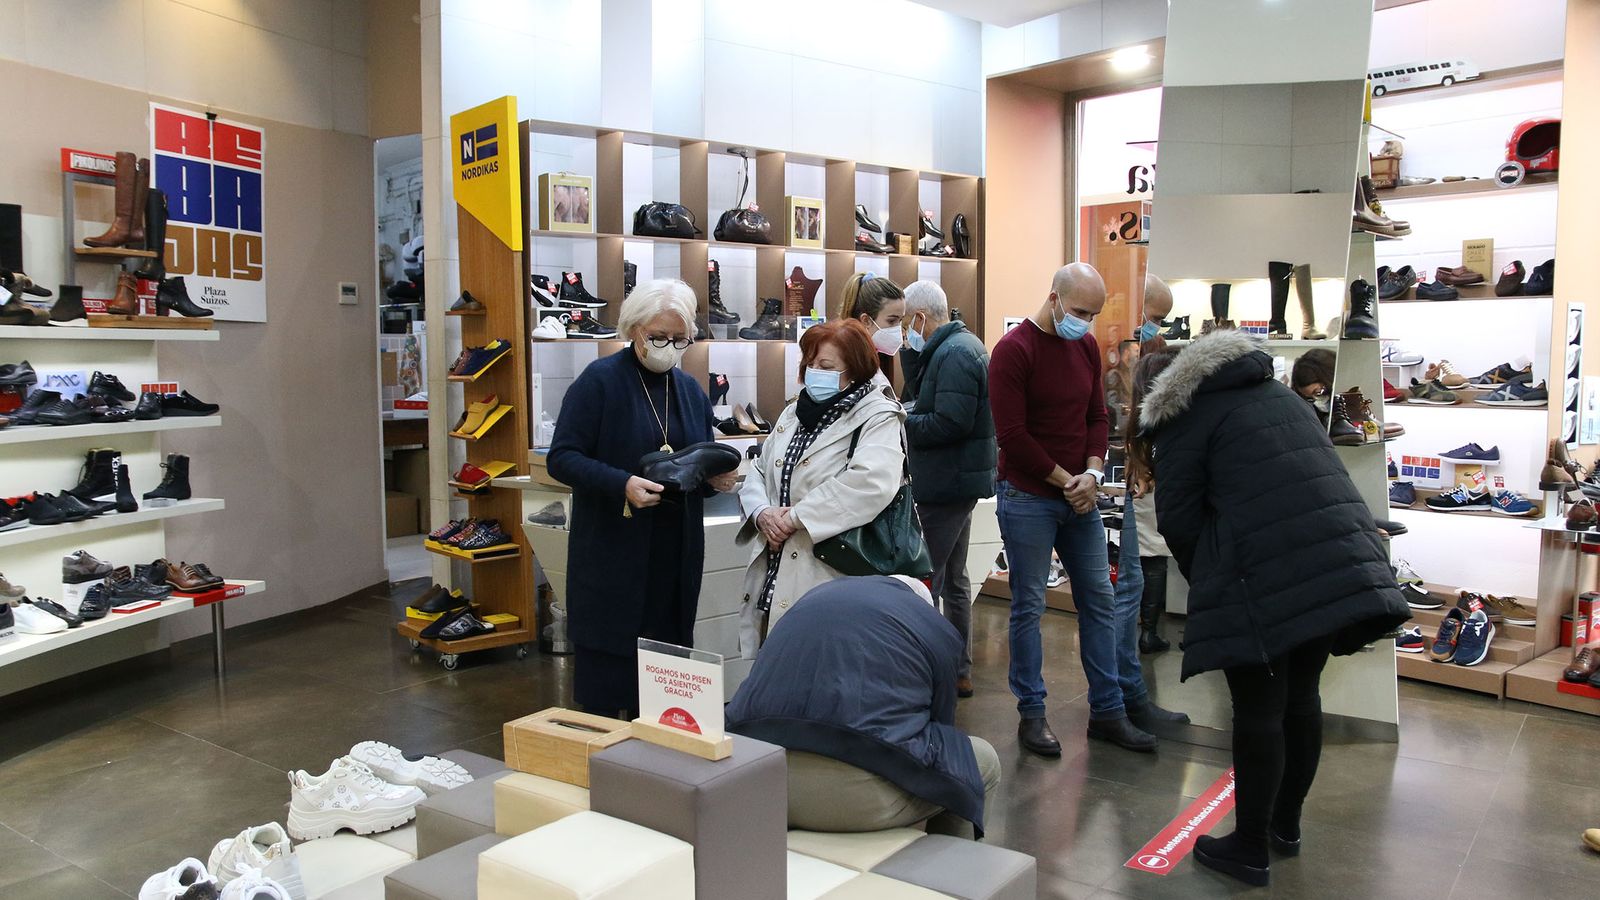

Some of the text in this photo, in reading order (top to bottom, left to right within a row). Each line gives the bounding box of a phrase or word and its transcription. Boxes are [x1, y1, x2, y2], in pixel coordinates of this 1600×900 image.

[463, 138, 473, 159] N
[461, 161, 499, 180] NORDIKAS
[204, 286, 227, 297] Plaza
[200, 295, 230, 306] Suizos.
[1500, 496, 1512, 507] N
[645, 665, 711, 685] ROGAMOS NO PISEN
[654, 675, 667, 684] LOS
[664, 686, 693, 699] GRACIAS
[1156, 830, 1189, 855] Mantenga
[1188, 805, 1215, 826] distancia
